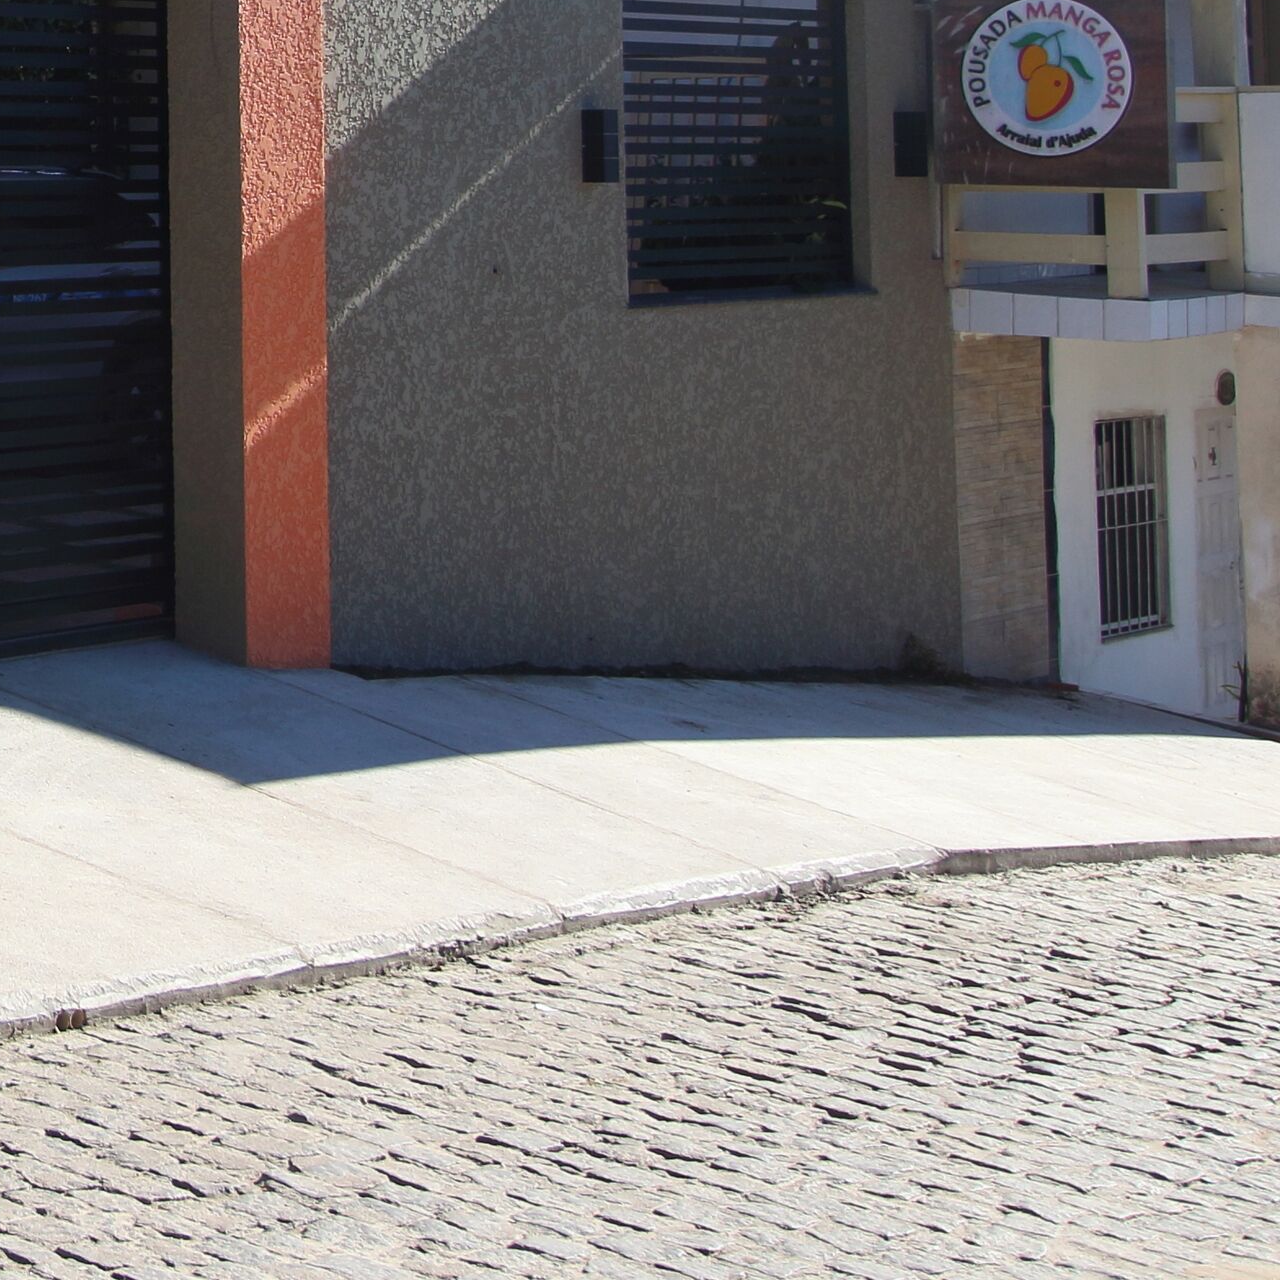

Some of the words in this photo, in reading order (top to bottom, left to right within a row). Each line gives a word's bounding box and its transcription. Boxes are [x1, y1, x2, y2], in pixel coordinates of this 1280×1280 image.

[967, 9, 1023, 109] POUSADA
[1025, 0, 1112, 49] MANGA
[1101, 48, 1126, 110] ROSA
[995, 123, 1042, 148] Arraial
[1045, 125, 1098, 149] d'Ajuda
